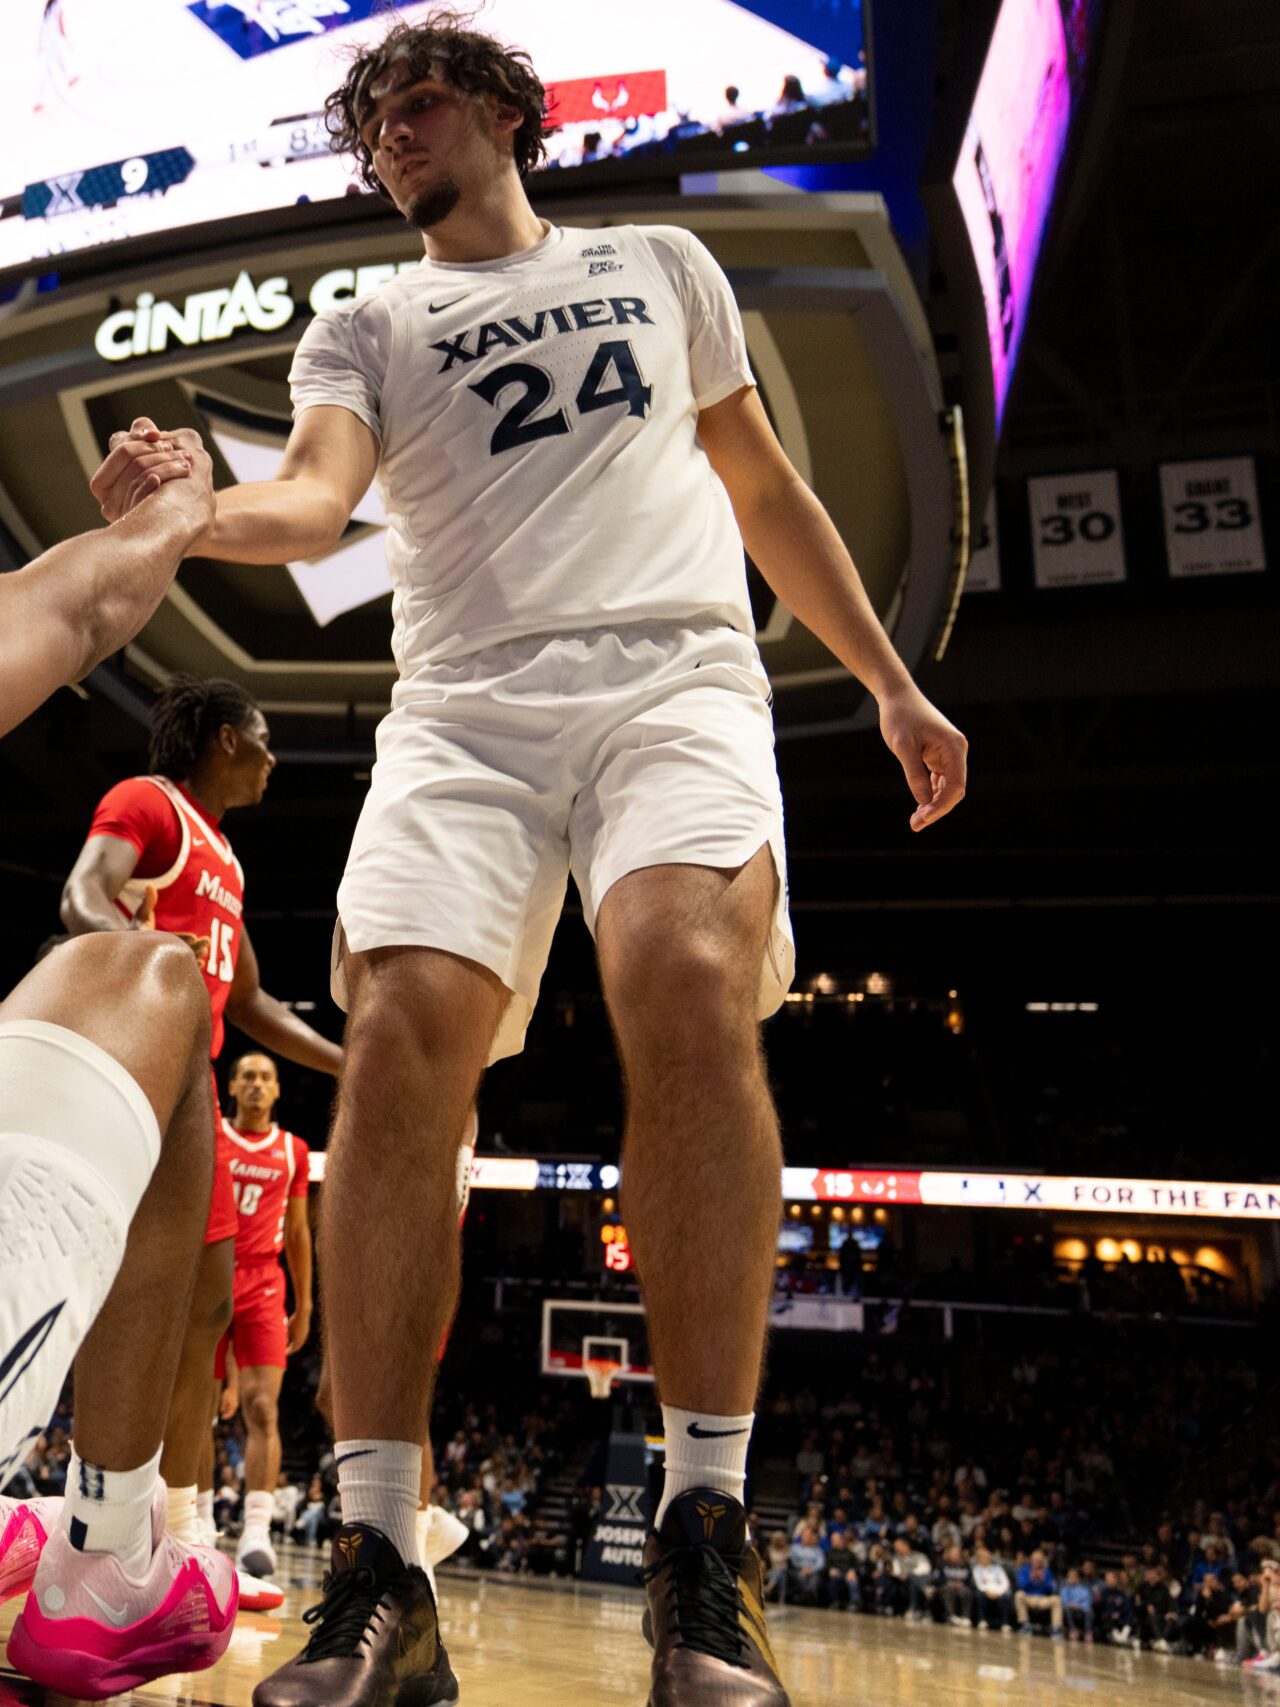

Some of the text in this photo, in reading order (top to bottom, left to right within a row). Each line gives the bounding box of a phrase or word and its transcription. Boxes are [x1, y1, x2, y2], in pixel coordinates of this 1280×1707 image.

[121, 158, 148, 193] 9
[428, 296, 657, 375] XAVIER
[467, 338, 655, 457] 24
[1039, 511, 1116, 546] 30
[1172, 500, 1253, 534] 33
[206, 917, 235, 983] 15
[599, 1164, 620, 1190] 9
[823, 1172, 855, 1198] 15
[1073, 1185, 1134, 1205] FOR
[1150, 1188, 1208, 1209] THE
[601, 1546, 644, 1568] AUTO
